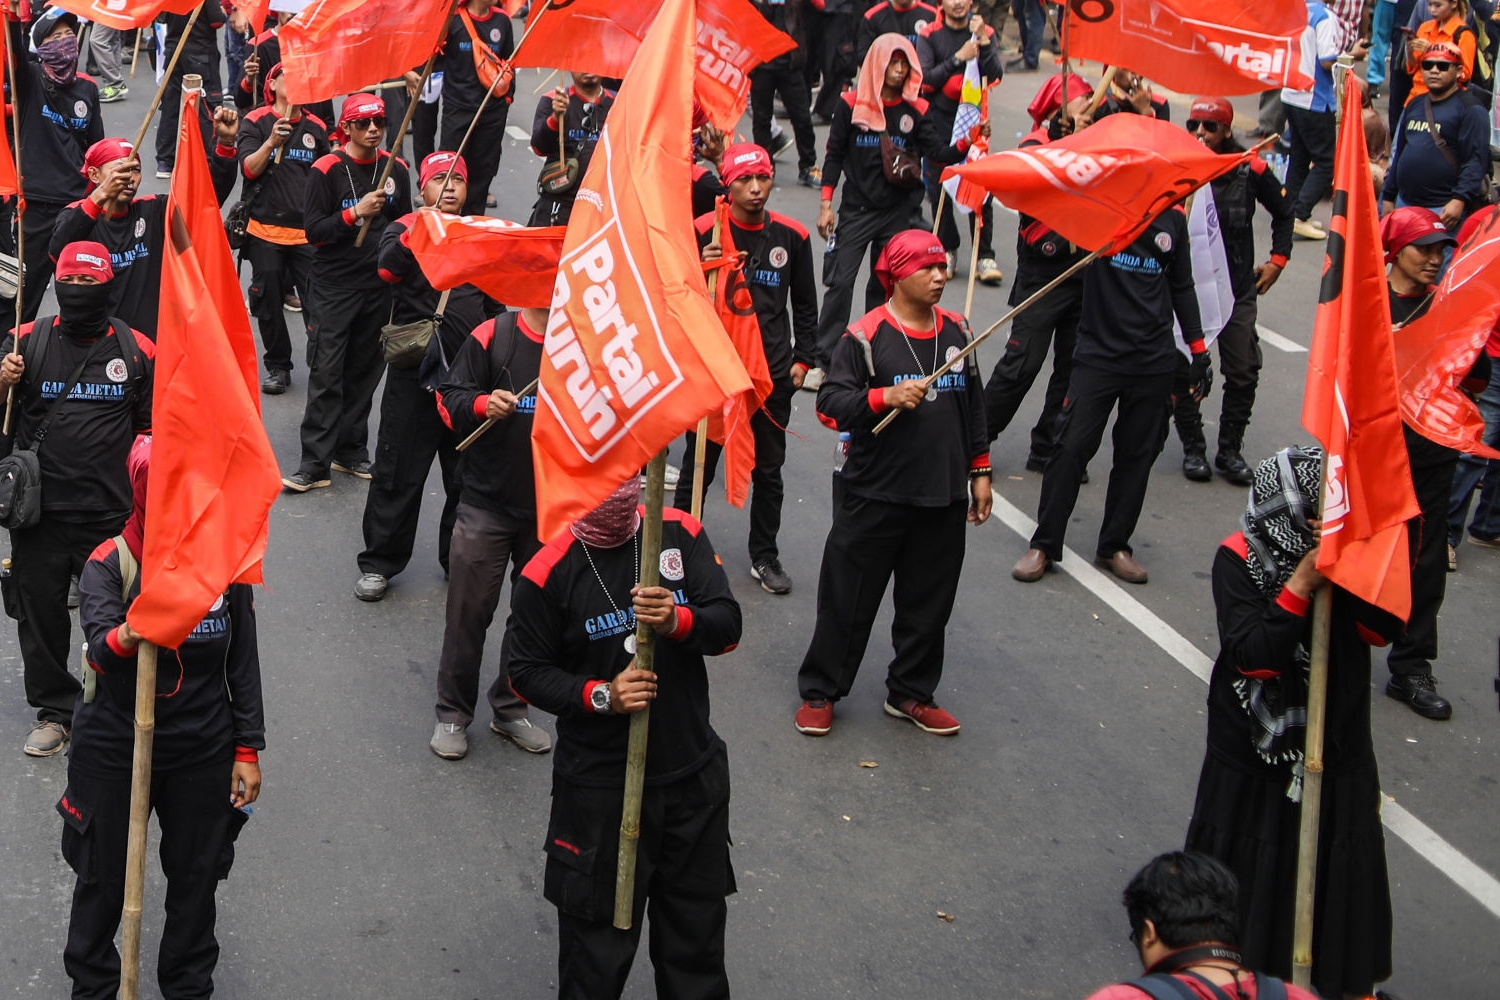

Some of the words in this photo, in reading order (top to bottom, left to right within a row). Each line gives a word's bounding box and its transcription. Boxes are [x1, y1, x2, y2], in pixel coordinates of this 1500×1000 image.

[571, 238, 660, 409] Partai
[85, 383, 125, 396] METAL
[936, 374, 966, 388] METAL
[585, 606, 636, 635] GARDA
